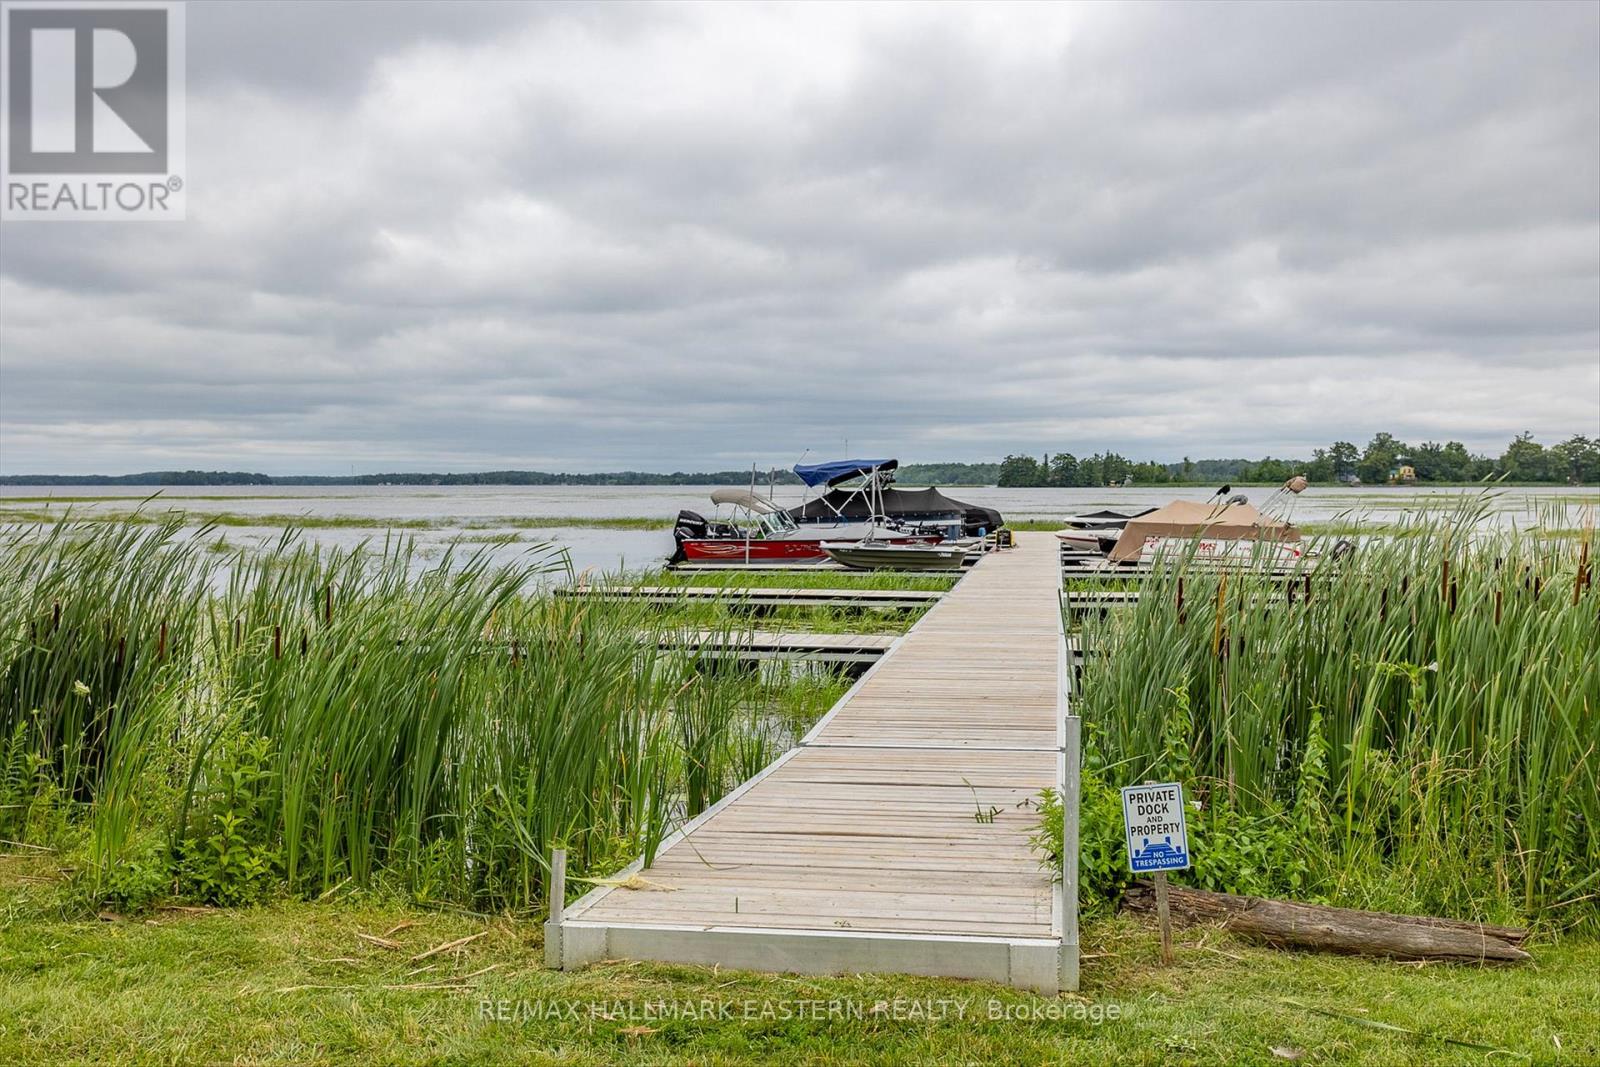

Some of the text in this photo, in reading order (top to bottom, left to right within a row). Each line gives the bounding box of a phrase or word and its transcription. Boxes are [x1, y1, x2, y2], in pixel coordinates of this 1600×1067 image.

[1129, 790, 1176, 804] PRIVATE
[1138, 803, 1169, 815] DOCK
[1131, 822, 1180, 836] PROPERTY
[1135, 857, 1183, 867] TRESPASSING
